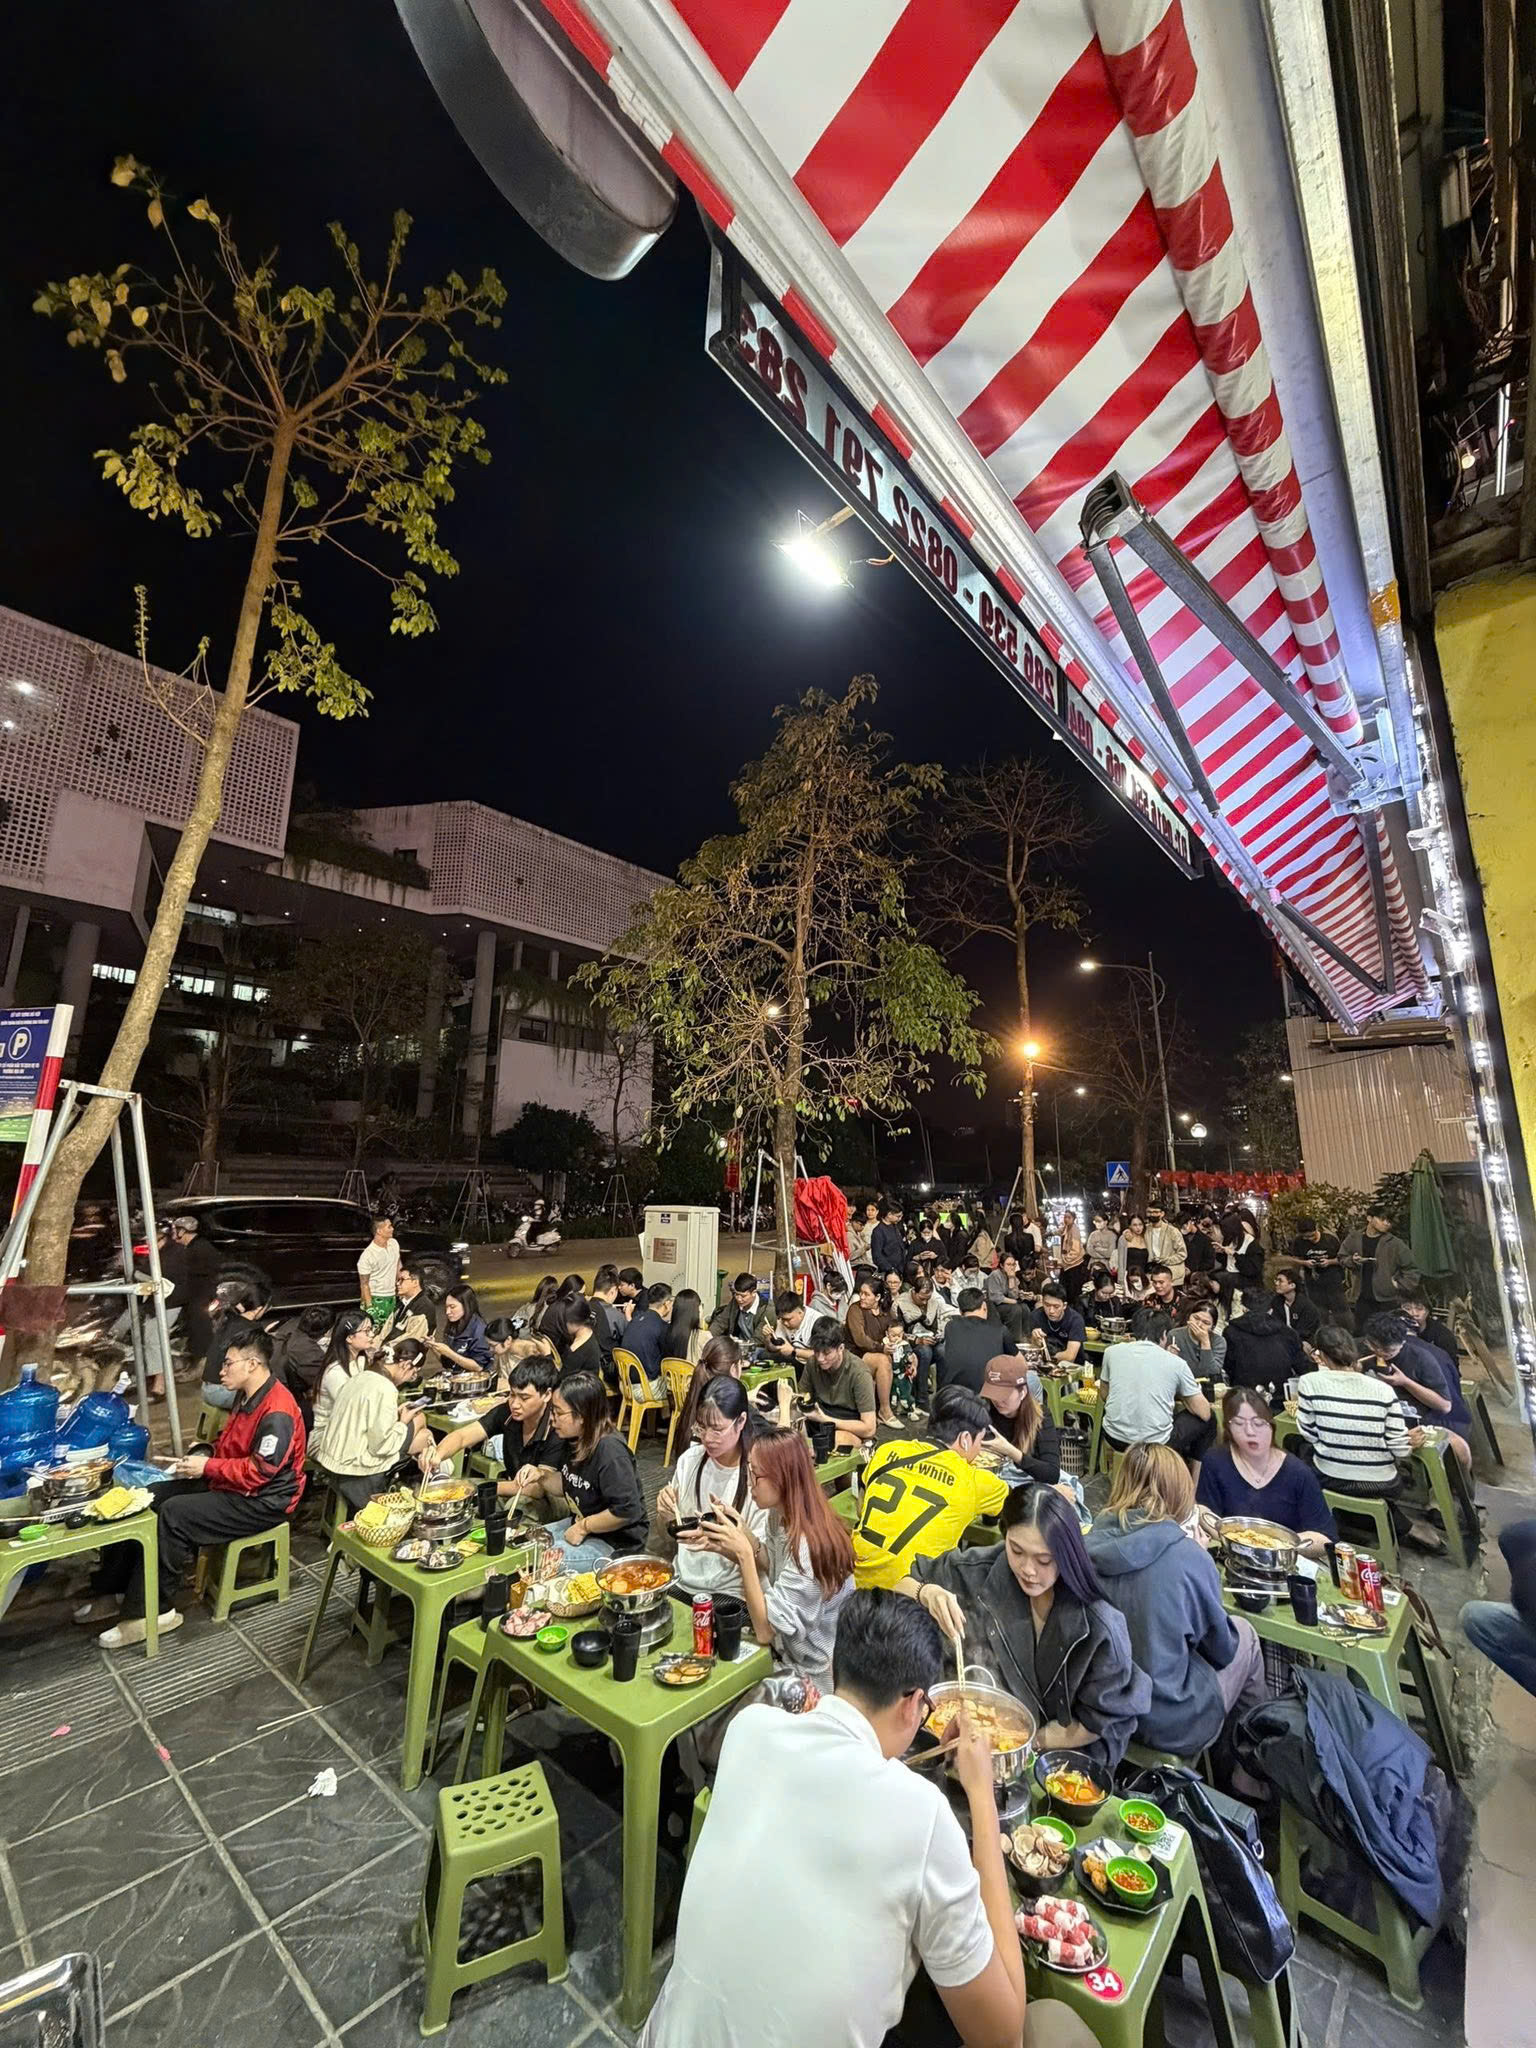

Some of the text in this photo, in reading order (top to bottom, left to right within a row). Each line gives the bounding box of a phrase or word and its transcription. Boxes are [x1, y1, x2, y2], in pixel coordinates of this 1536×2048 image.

[12, 1033, 28, 1056] P
[919, 1463, 955, 1487] White
[860, 1473, 949, 1555] 27
[1088, 1971, 1120, 1992] 34
